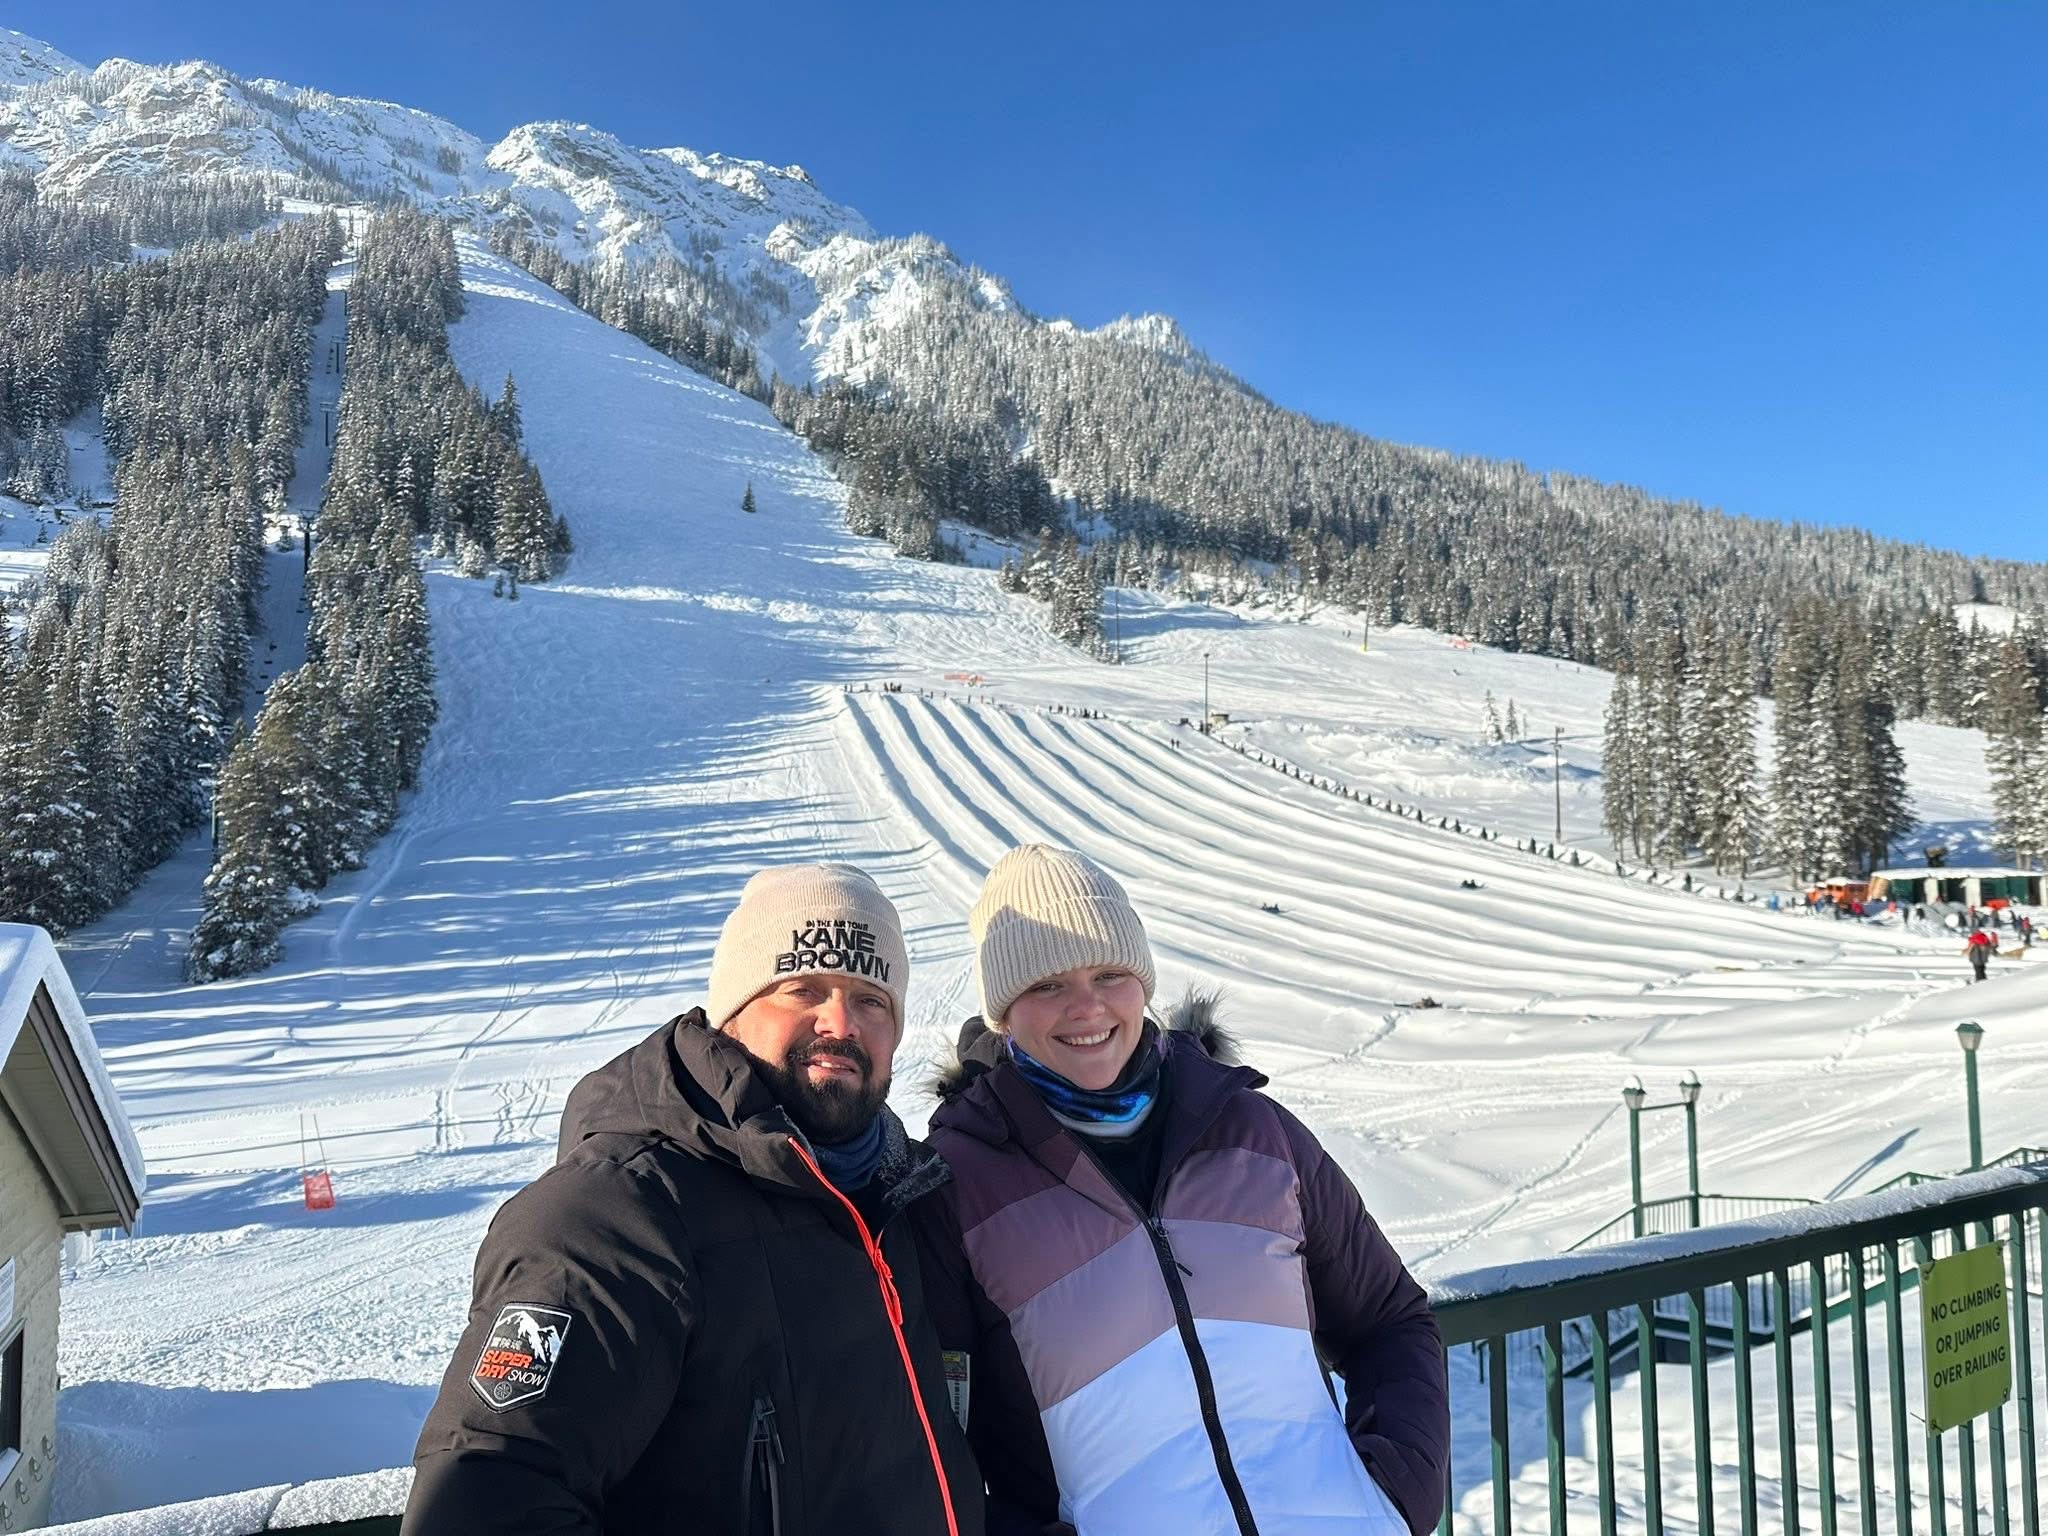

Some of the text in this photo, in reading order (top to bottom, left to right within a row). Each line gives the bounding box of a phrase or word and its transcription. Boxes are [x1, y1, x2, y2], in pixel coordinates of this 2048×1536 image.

[817, 920, 832, 928] THE
[792, 929, 876, 954] KANE
[775, 949, 890, 983] BROWN
[1931, 1284, 2001, 1322] NO CLIMBING
[1936, 1316, 2000, 1354] OR JUMPING
[482, 1350, 533, 1368] SUPER
[1934, 1346, 2006, 1388] OVER RAILING
[476, 1364, 546, 1386] DRY SNOW
